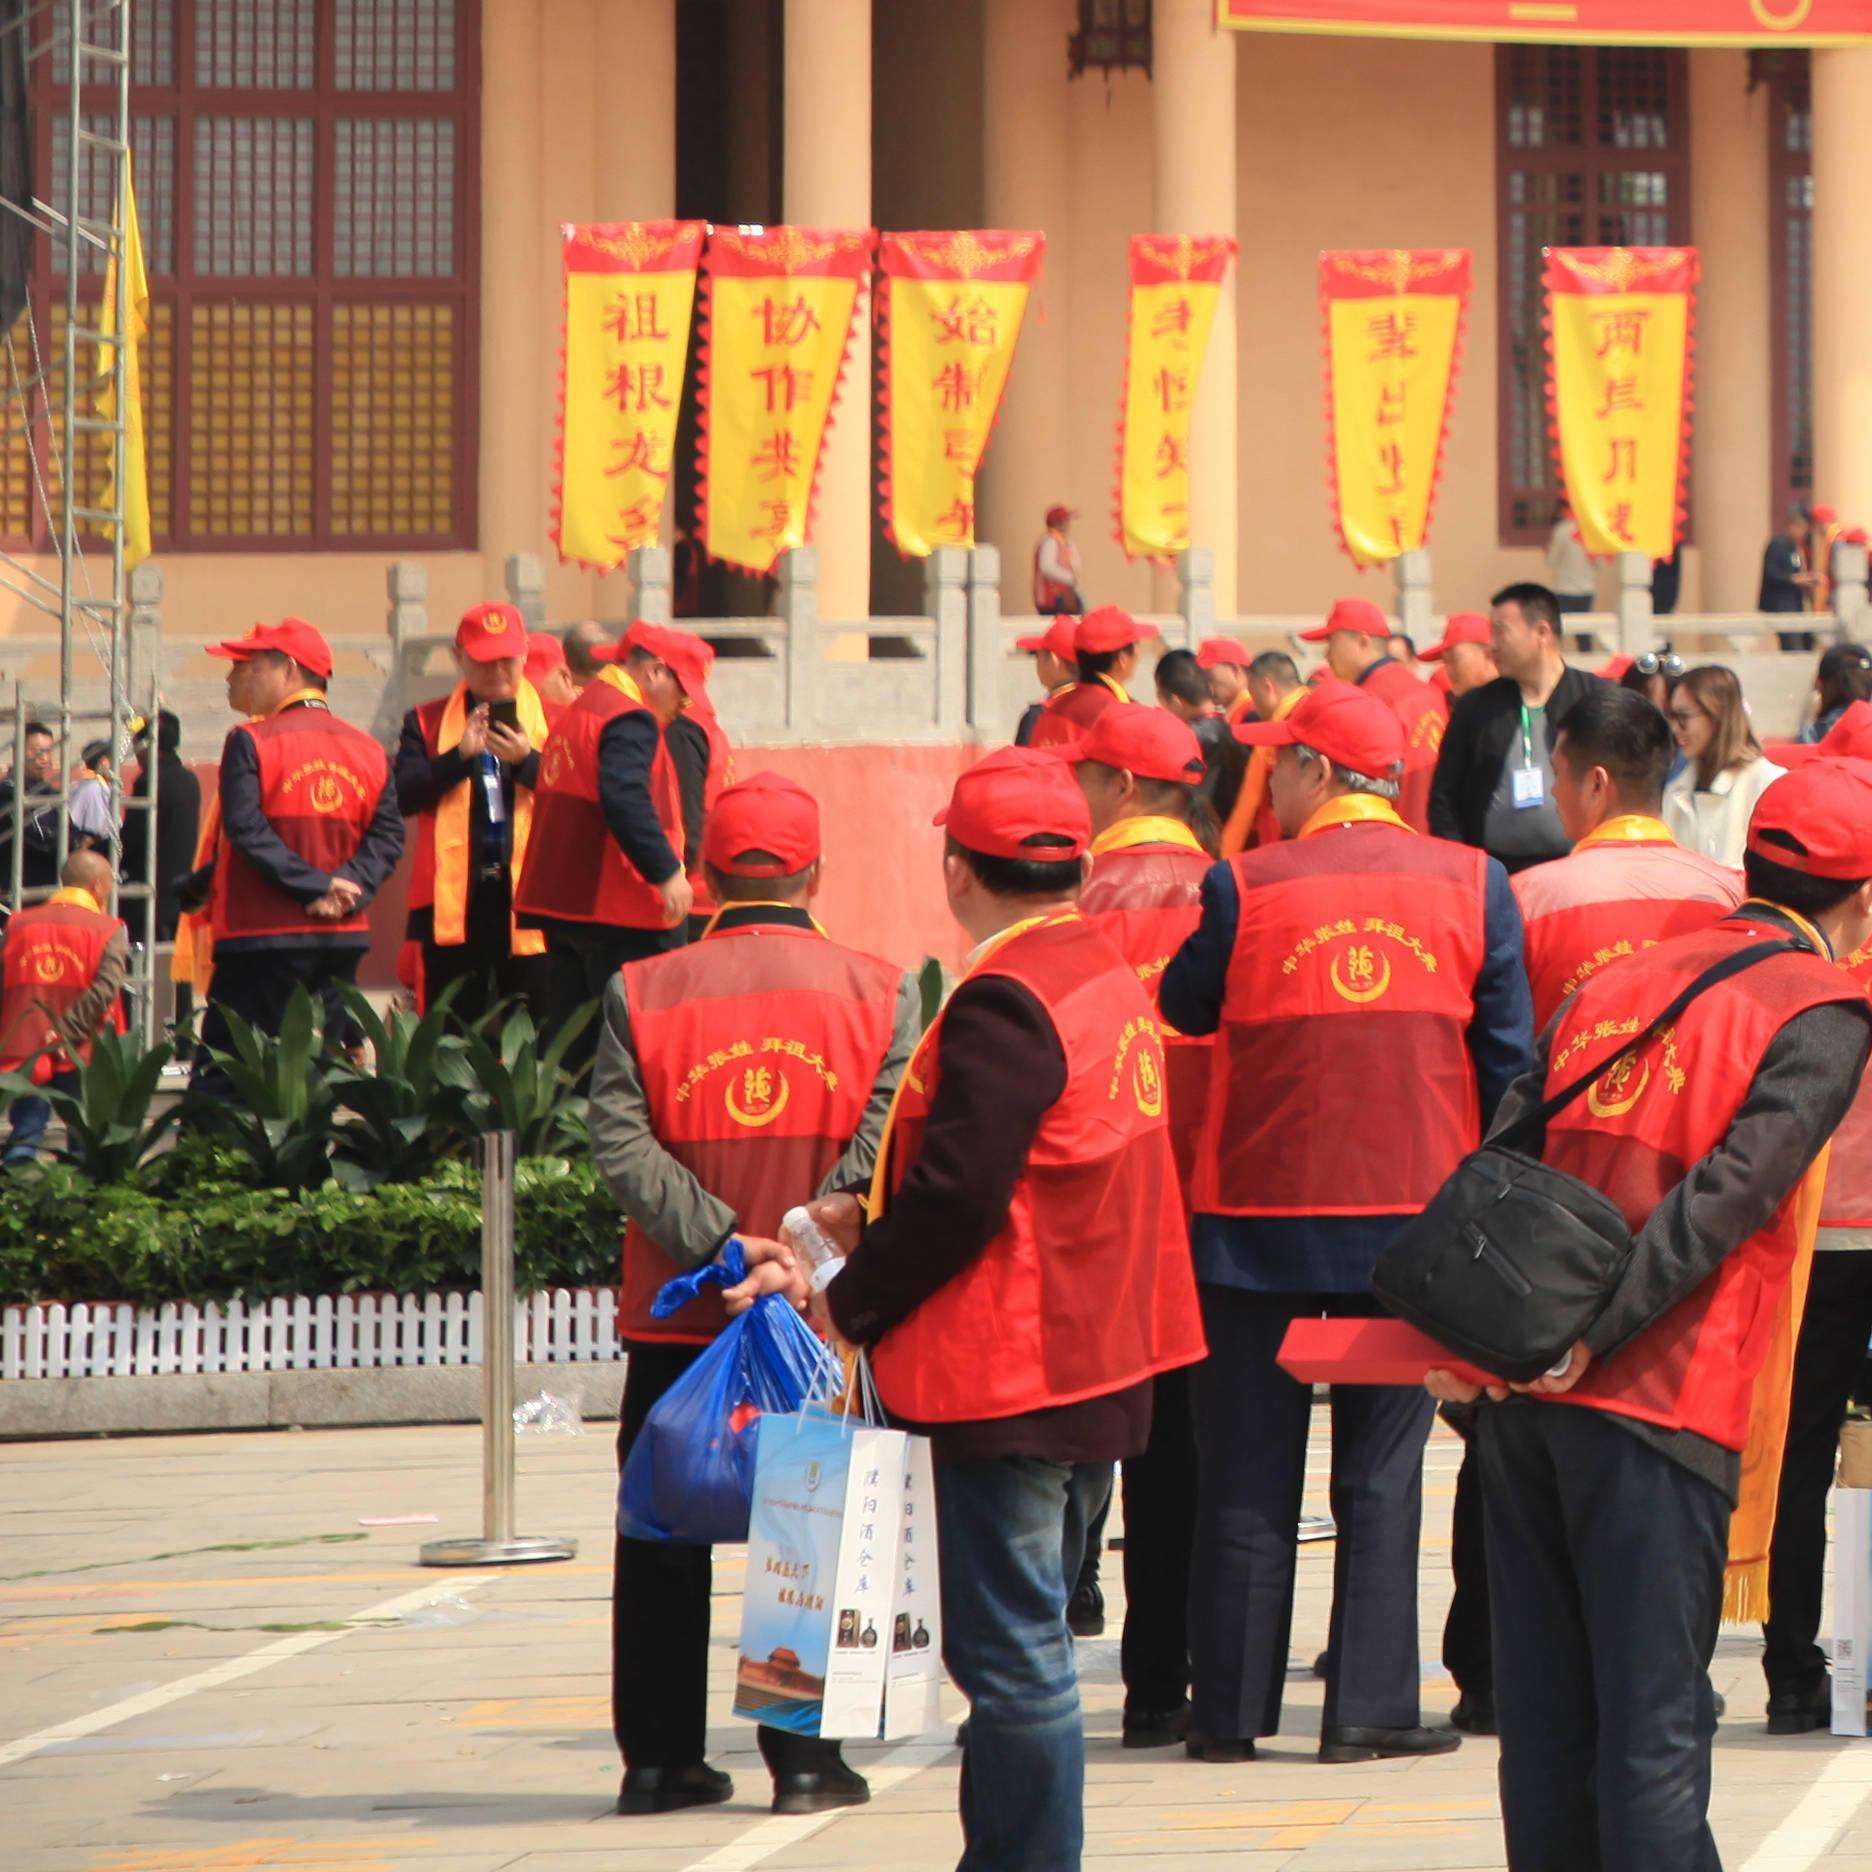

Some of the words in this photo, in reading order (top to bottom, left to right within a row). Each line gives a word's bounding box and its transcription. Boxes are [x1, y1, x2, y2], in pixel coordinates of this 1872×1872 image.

[1282, 916, 1438, 975] 中华张姓拜祖大典
[673, 1036, 839, 1103] 中华张姓拜祖大典
